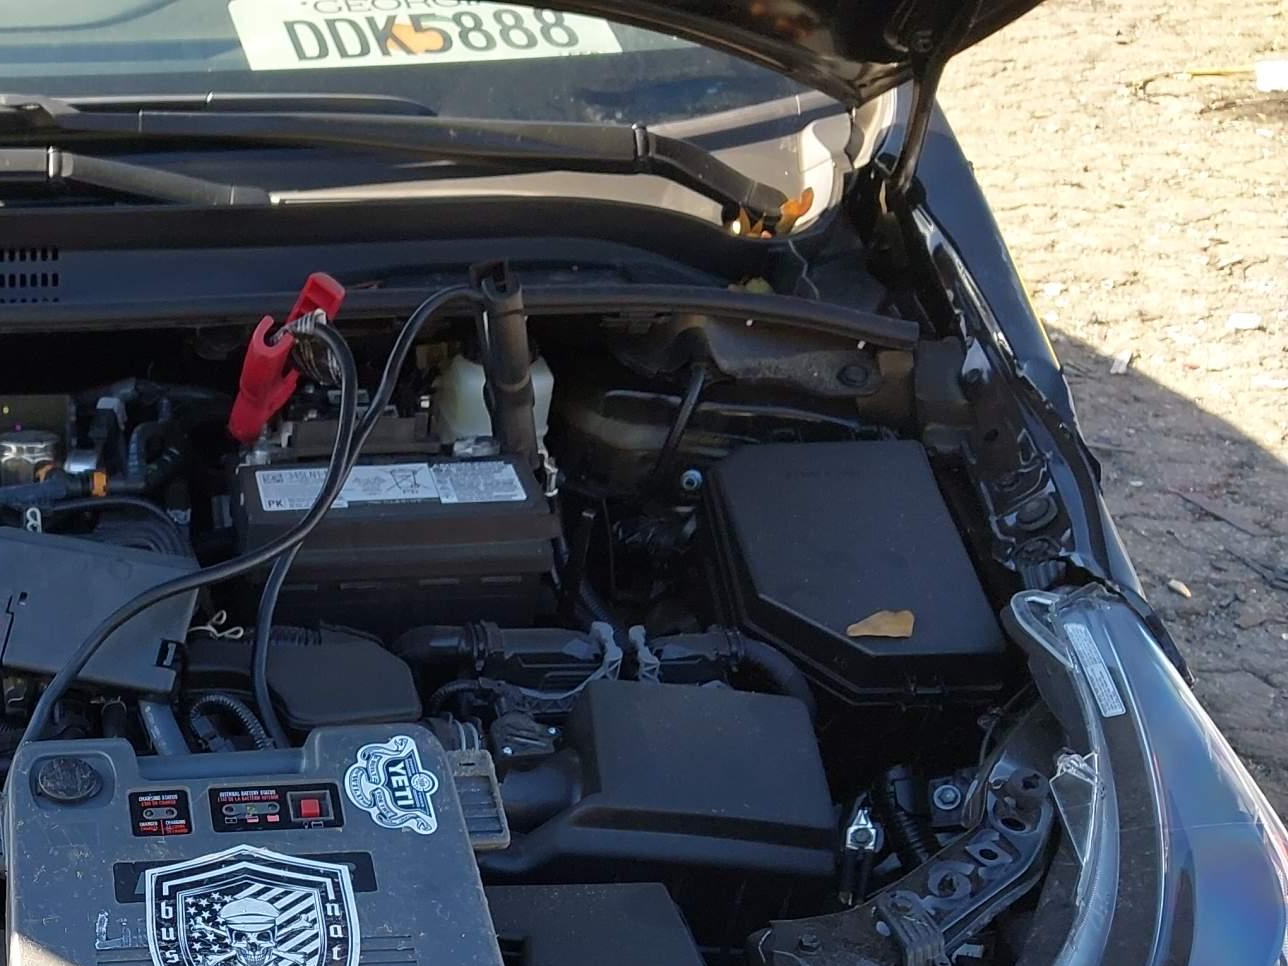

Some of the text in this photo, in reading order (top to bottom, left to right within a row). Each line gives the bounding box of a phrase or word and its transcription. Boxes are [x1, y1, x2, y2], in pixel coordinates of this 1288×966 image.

[283, 8, 579, 62] DDK5888
[351, 773, 366, 803] WILD
[388, 760, 414, 807] YETI
